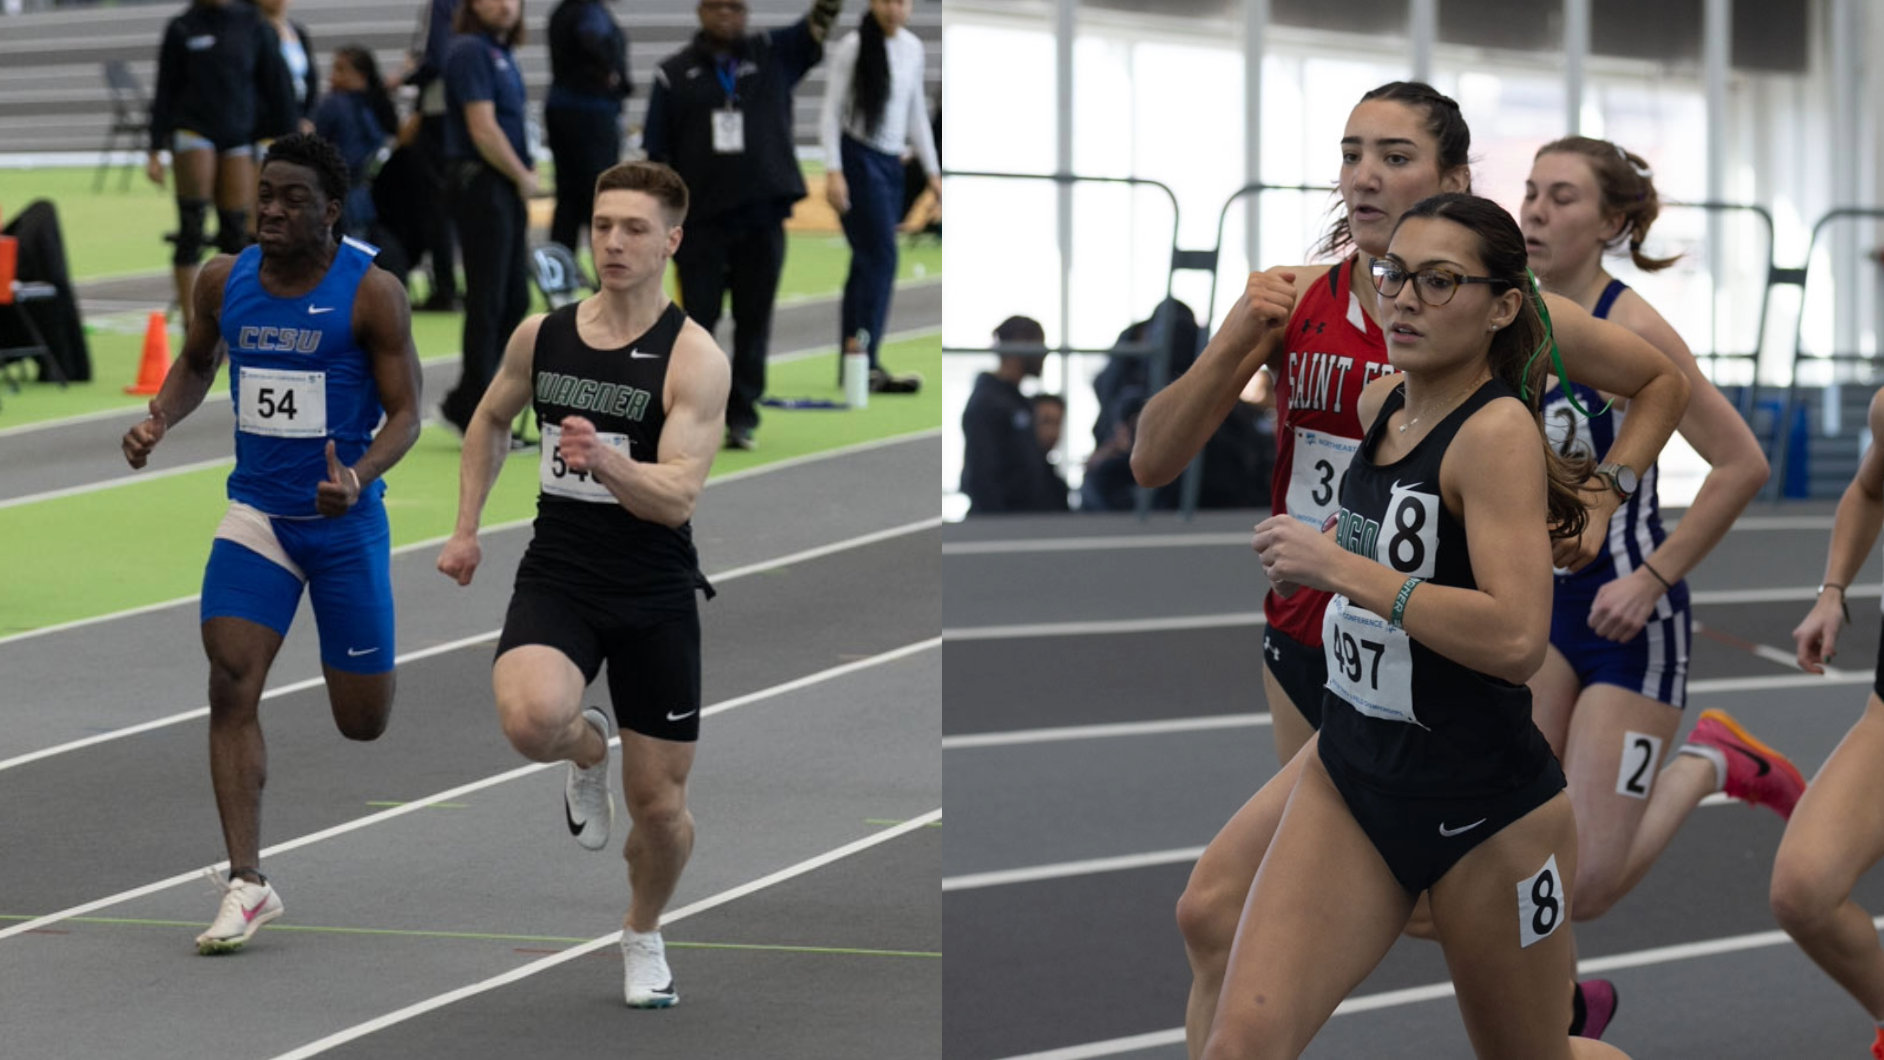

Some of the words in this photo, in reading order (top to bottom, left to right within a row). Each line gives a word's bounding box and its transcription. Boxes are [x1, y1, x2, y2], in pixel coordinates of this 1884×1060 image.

[239, 326, 322, 353] CCSU
[258, 388, 297, 420] 54
[537, 371, 651, 421] WAGNER
[1288, 351, 1353, 413] SAINT
[1554, 407, 1584, 457] 2
[552, 445, 603, 484] 54
[1311, 459, 1349, 507] 3
[1336, 507, 1379, 562] AGN
[1388, 496, 1426, 573] 8
[1343, 612, 1383, 628] CONFERENCE
[1334, 624, 1385, 690] 497
[1626, 738, 1652, 794] 2
[1531, 869, 1558, 935] 8
